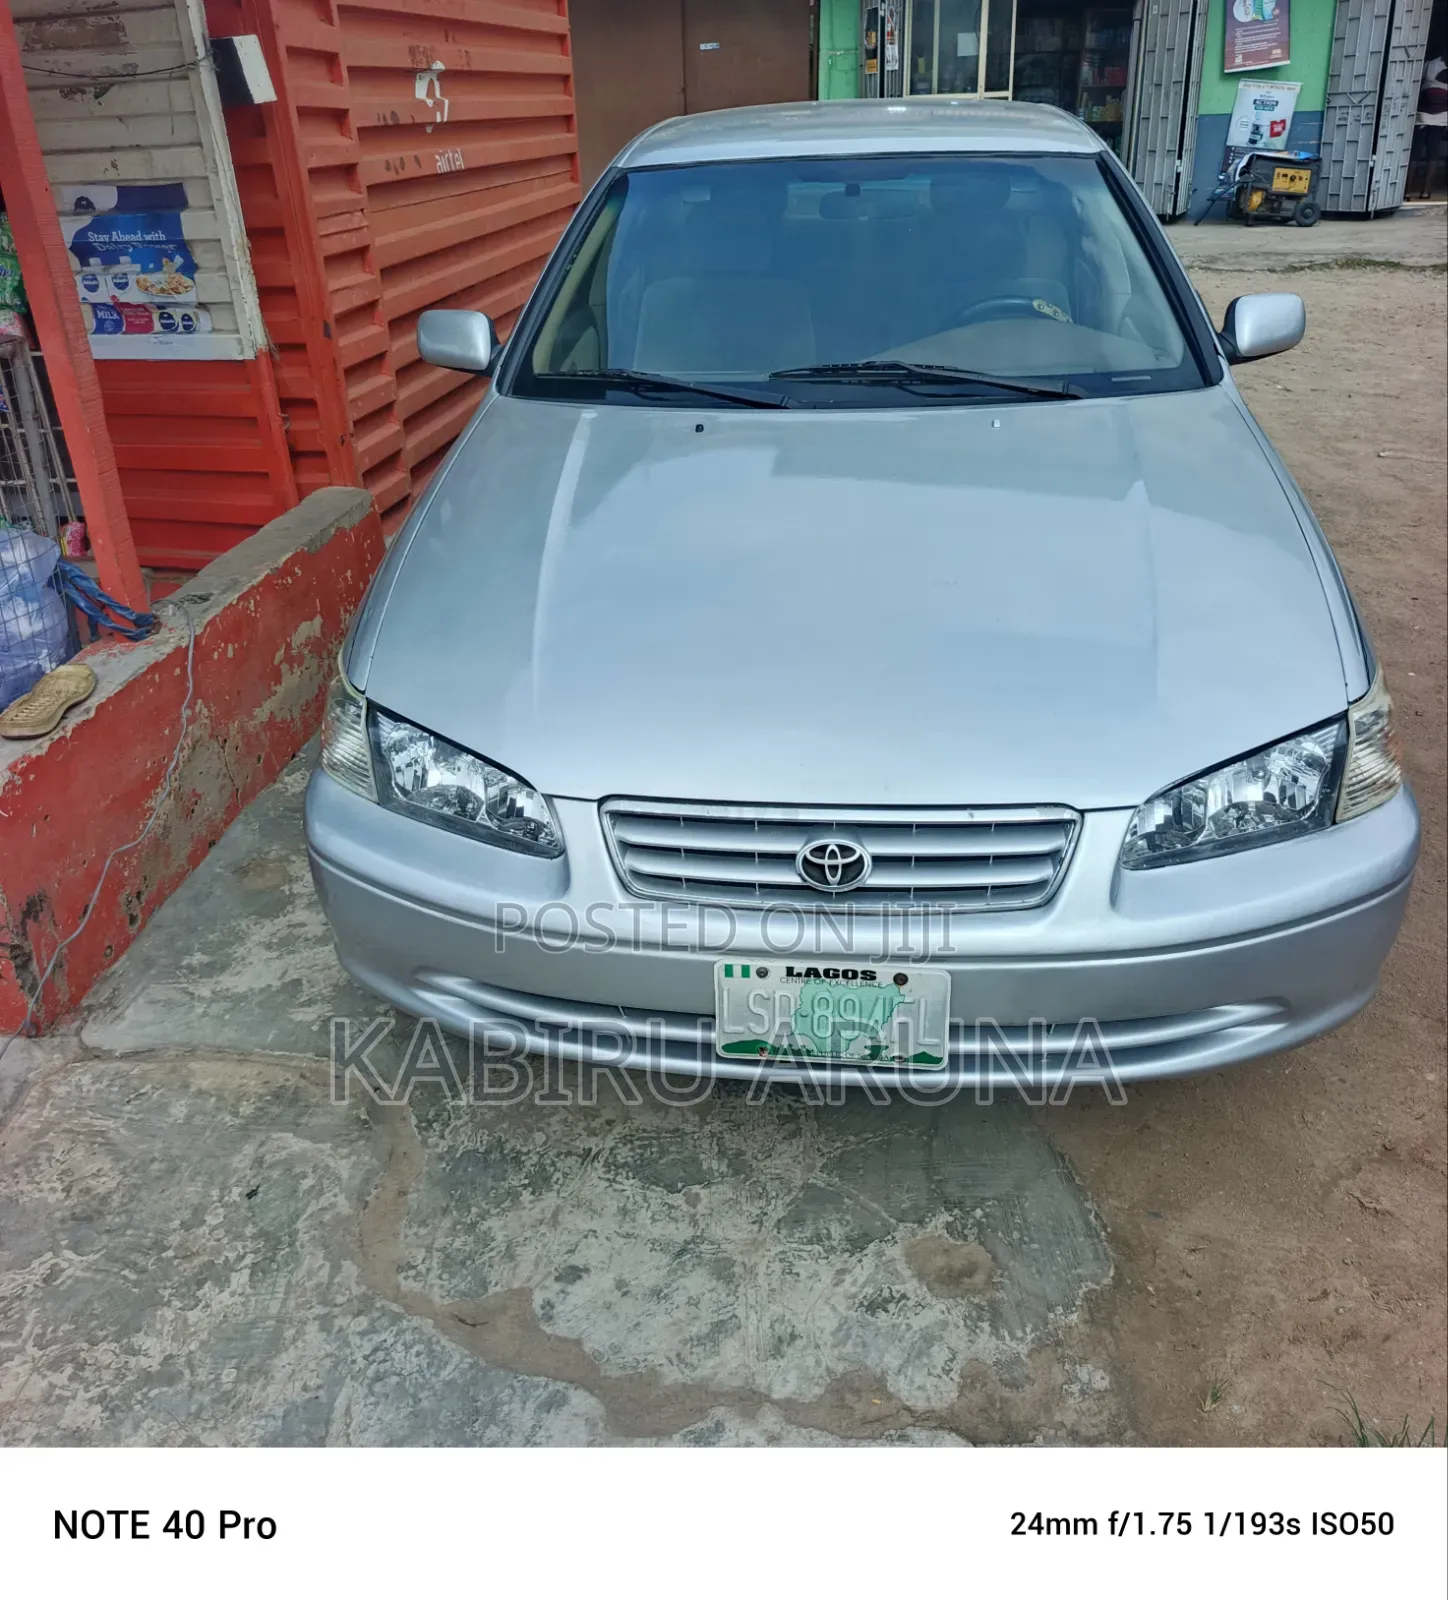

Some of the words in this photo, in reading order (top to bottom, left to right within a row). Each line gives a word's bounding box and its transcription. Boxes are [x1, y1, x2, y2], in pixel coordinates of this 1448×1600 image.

[435, 148, 465, 173] airtel
[88, 231, 109, 243] Stay
[112, 230, 142, 242] Ahead
[144, 230, 166, 241] with
[97, 309, 120, 321] MILK
[786, 966, 877, 981] LAGOS
